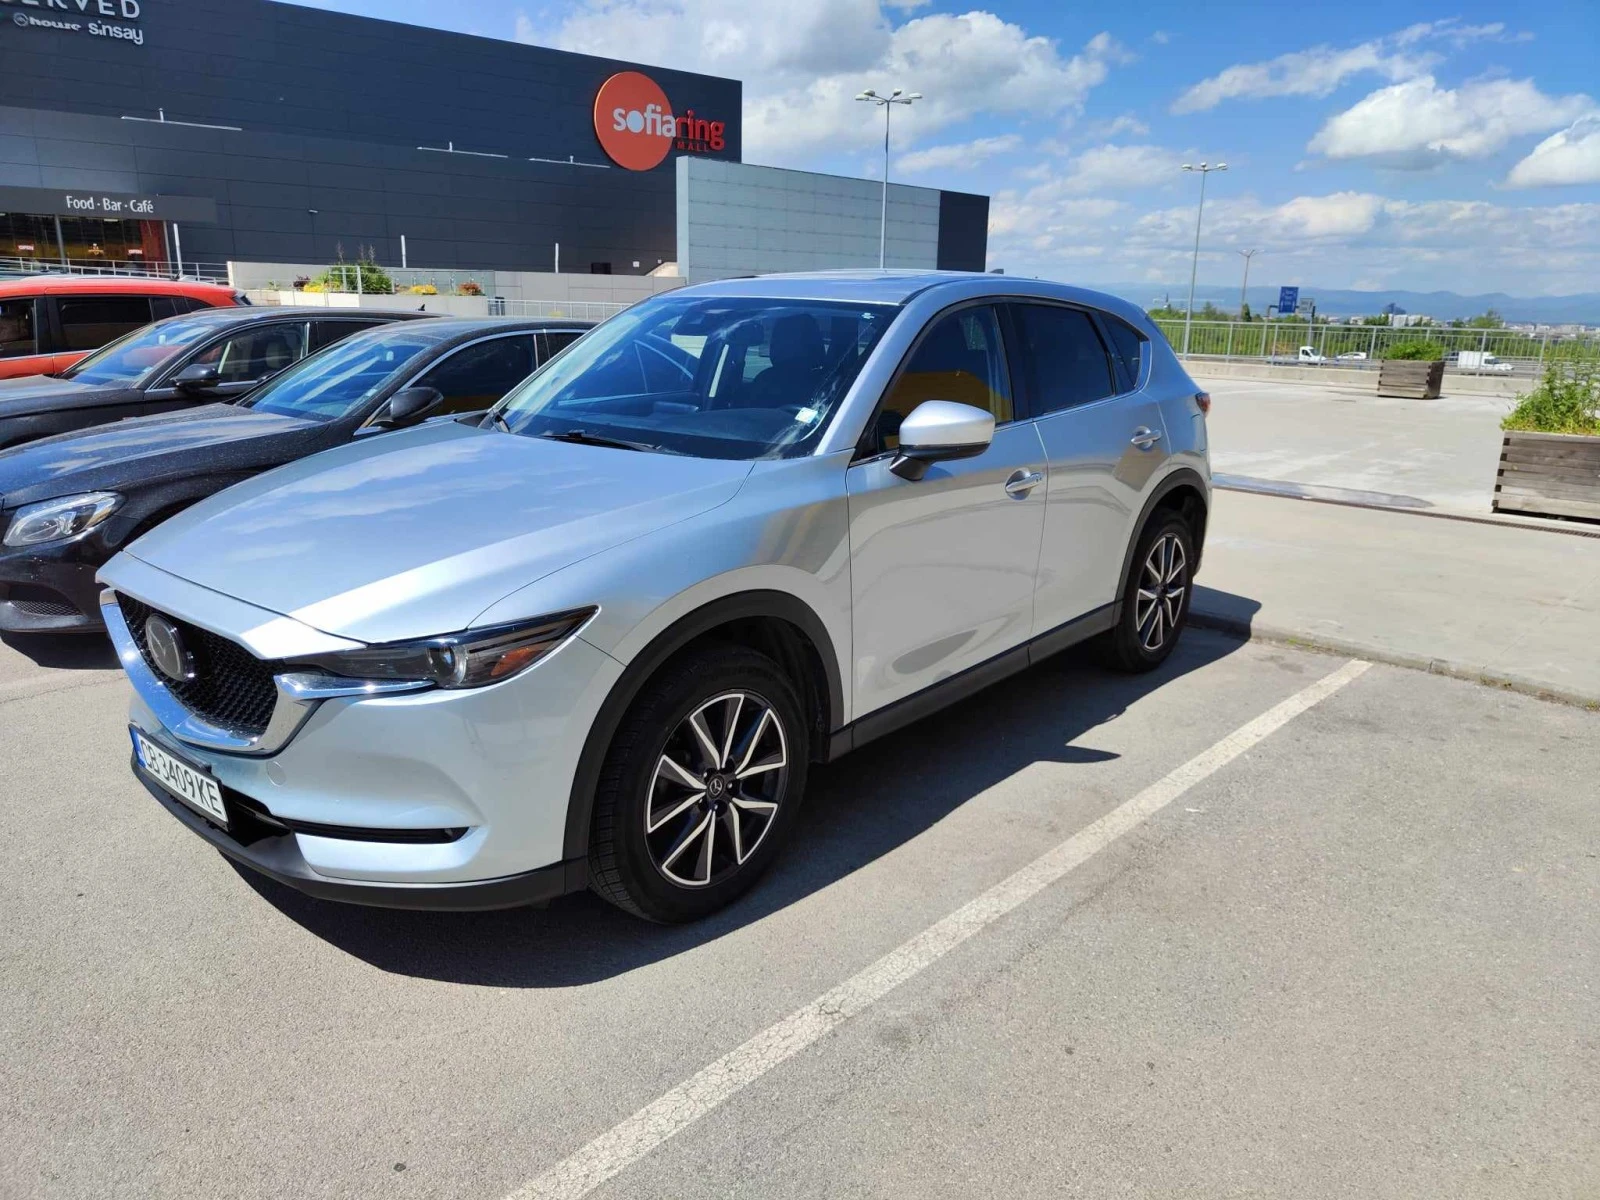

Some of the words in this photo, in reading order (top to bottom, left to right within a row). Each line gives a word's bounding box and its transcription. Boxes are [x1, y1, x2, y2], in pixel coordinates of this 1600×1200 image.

[88, 20, 144, 45] sinsay
[66, 195, 94, 210] Food
[103, 198, 121, 212] Bar
[130, 200, 154, 214] Café
